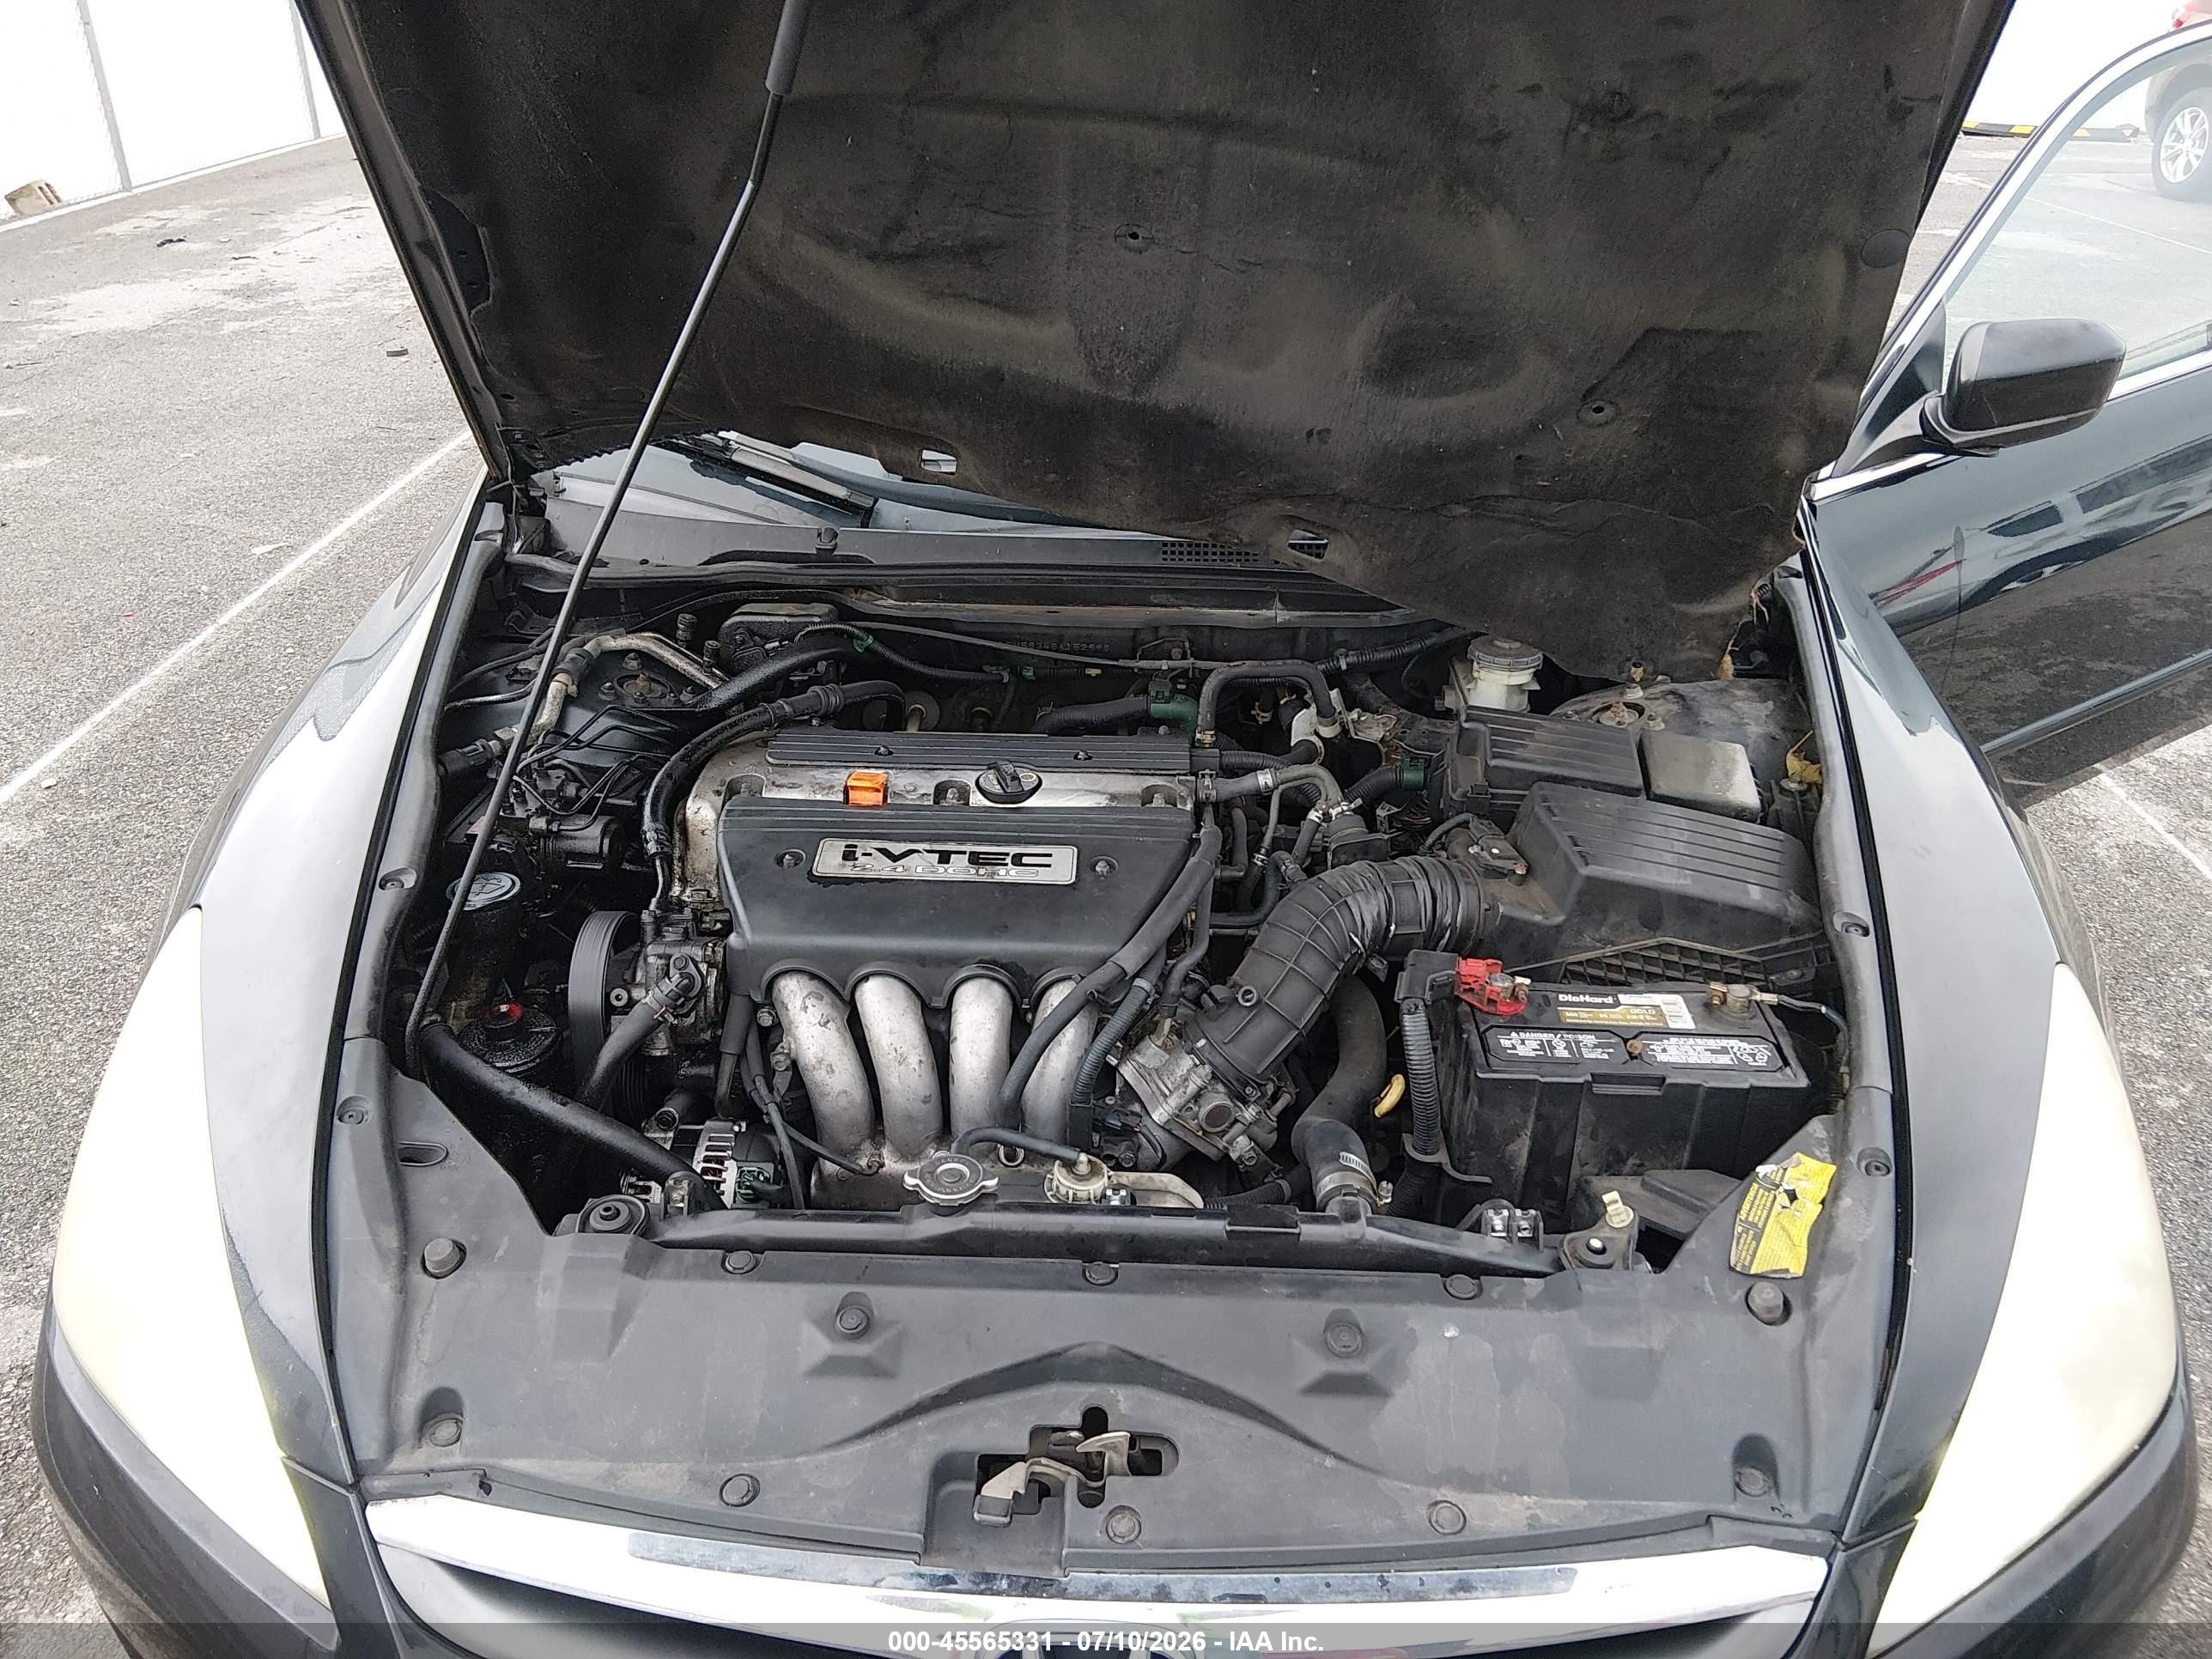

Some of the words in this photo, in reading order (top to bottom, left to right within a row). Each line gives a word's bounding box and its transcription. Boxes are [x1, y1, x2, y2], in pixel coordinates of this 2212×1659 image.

[842, 843, 1053, 868] i-VTEC
[850, 863, 908, 872] 2.4
[915, 865, 1039, 877] DOHC
